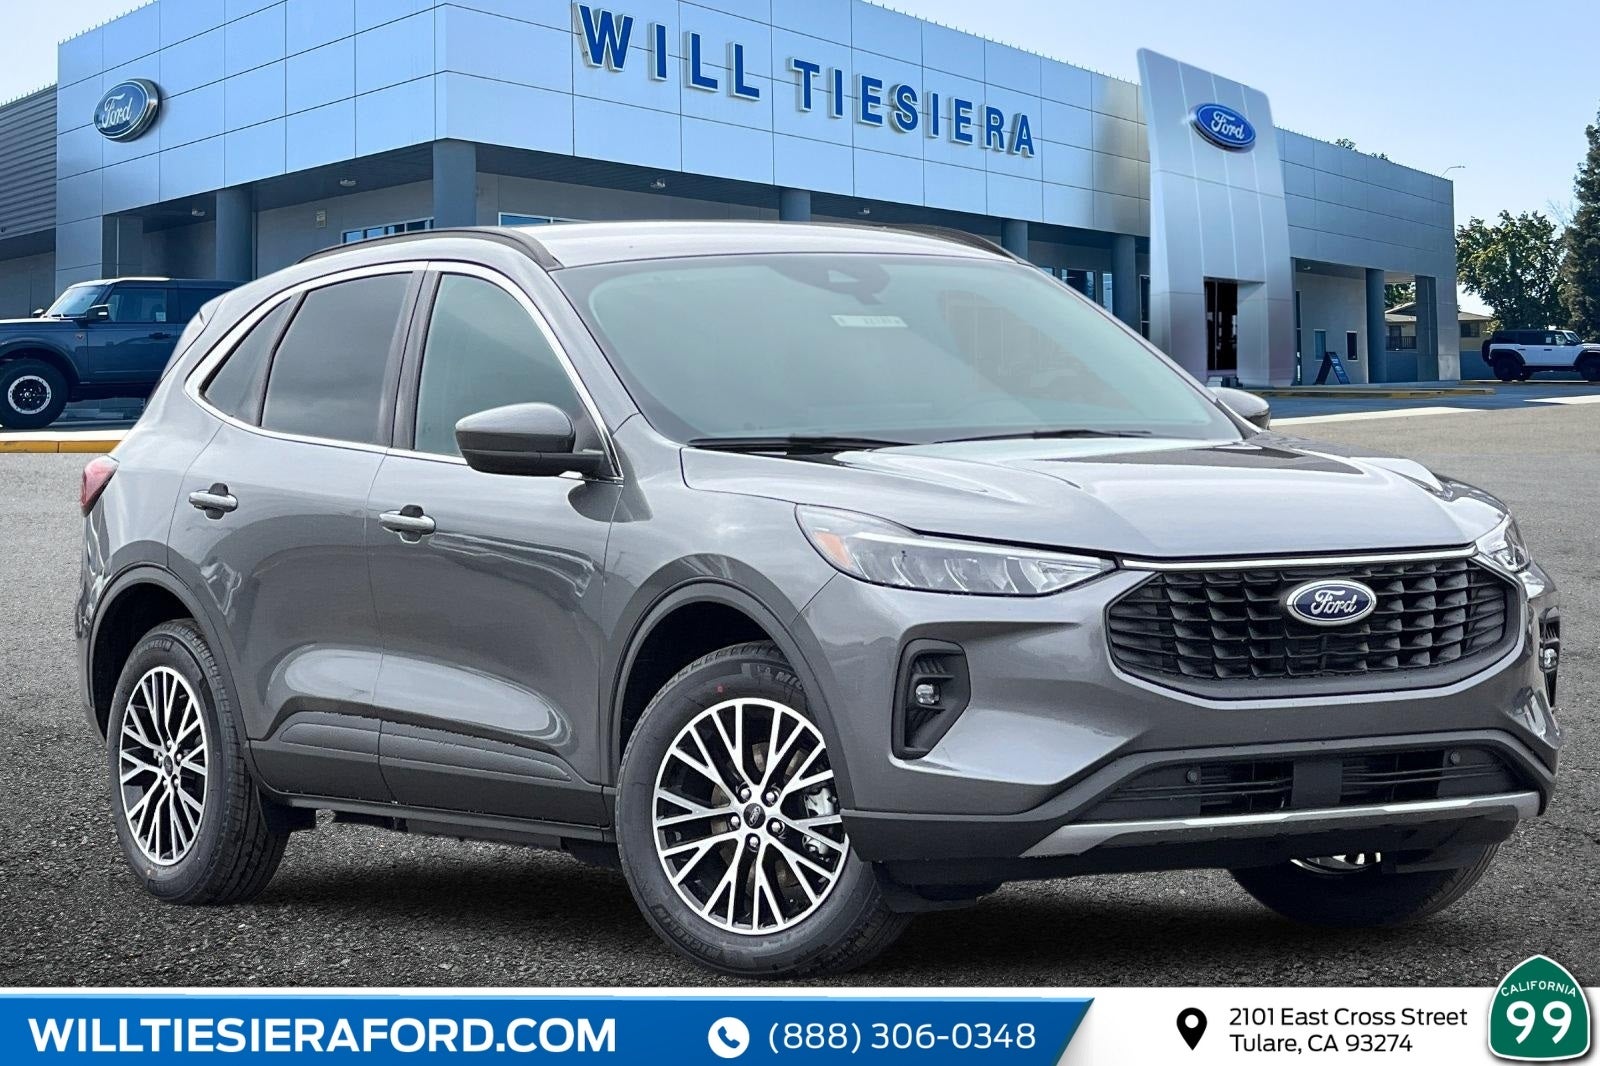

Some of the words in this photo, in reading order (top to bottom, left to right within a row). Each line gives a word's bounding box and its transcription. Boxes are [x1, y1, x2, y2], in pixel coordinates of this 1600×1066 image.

[573, 2, 760, 100] WILL
[788, 57, 1036, 158] TIESIERA
[101, 93, 133, 128] Ford
[1211, 110, 1245, 139] Ford
[1310, 589, 1358, 614] Ford
